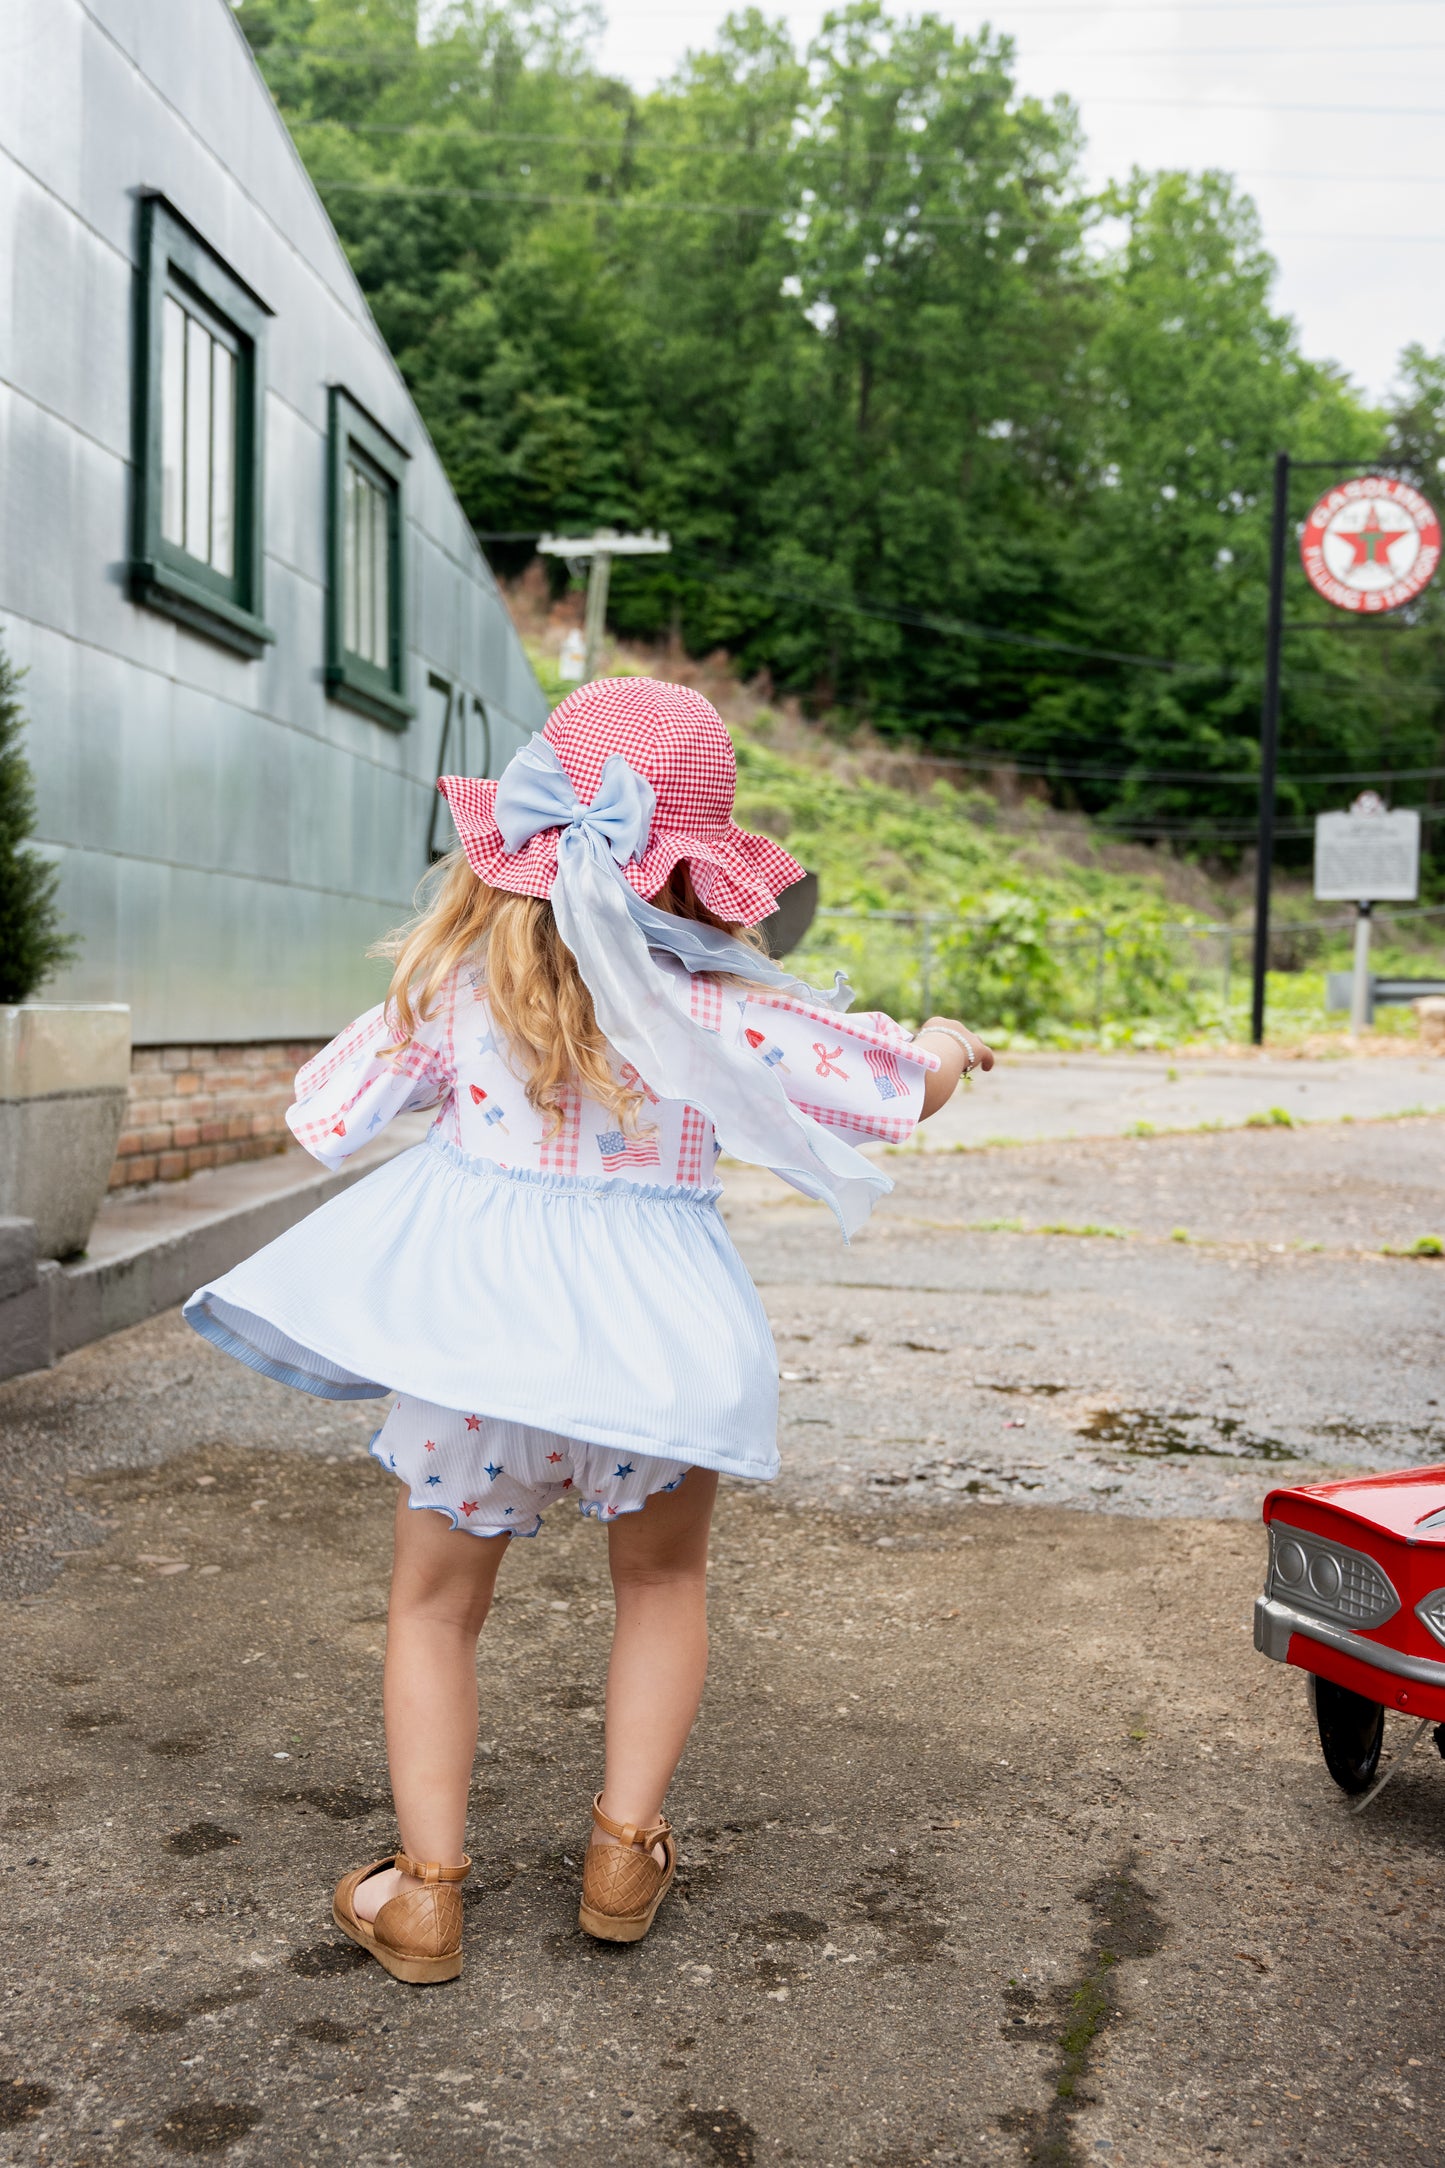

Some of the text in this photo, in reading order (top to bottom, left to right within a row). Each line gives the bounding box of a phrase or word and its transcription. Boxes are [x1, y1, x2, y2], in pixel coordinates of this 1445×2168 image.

[1311, 478, 1437, 530] GASOLINE
[1304, 545, 1439, 610] FILLING STATION
